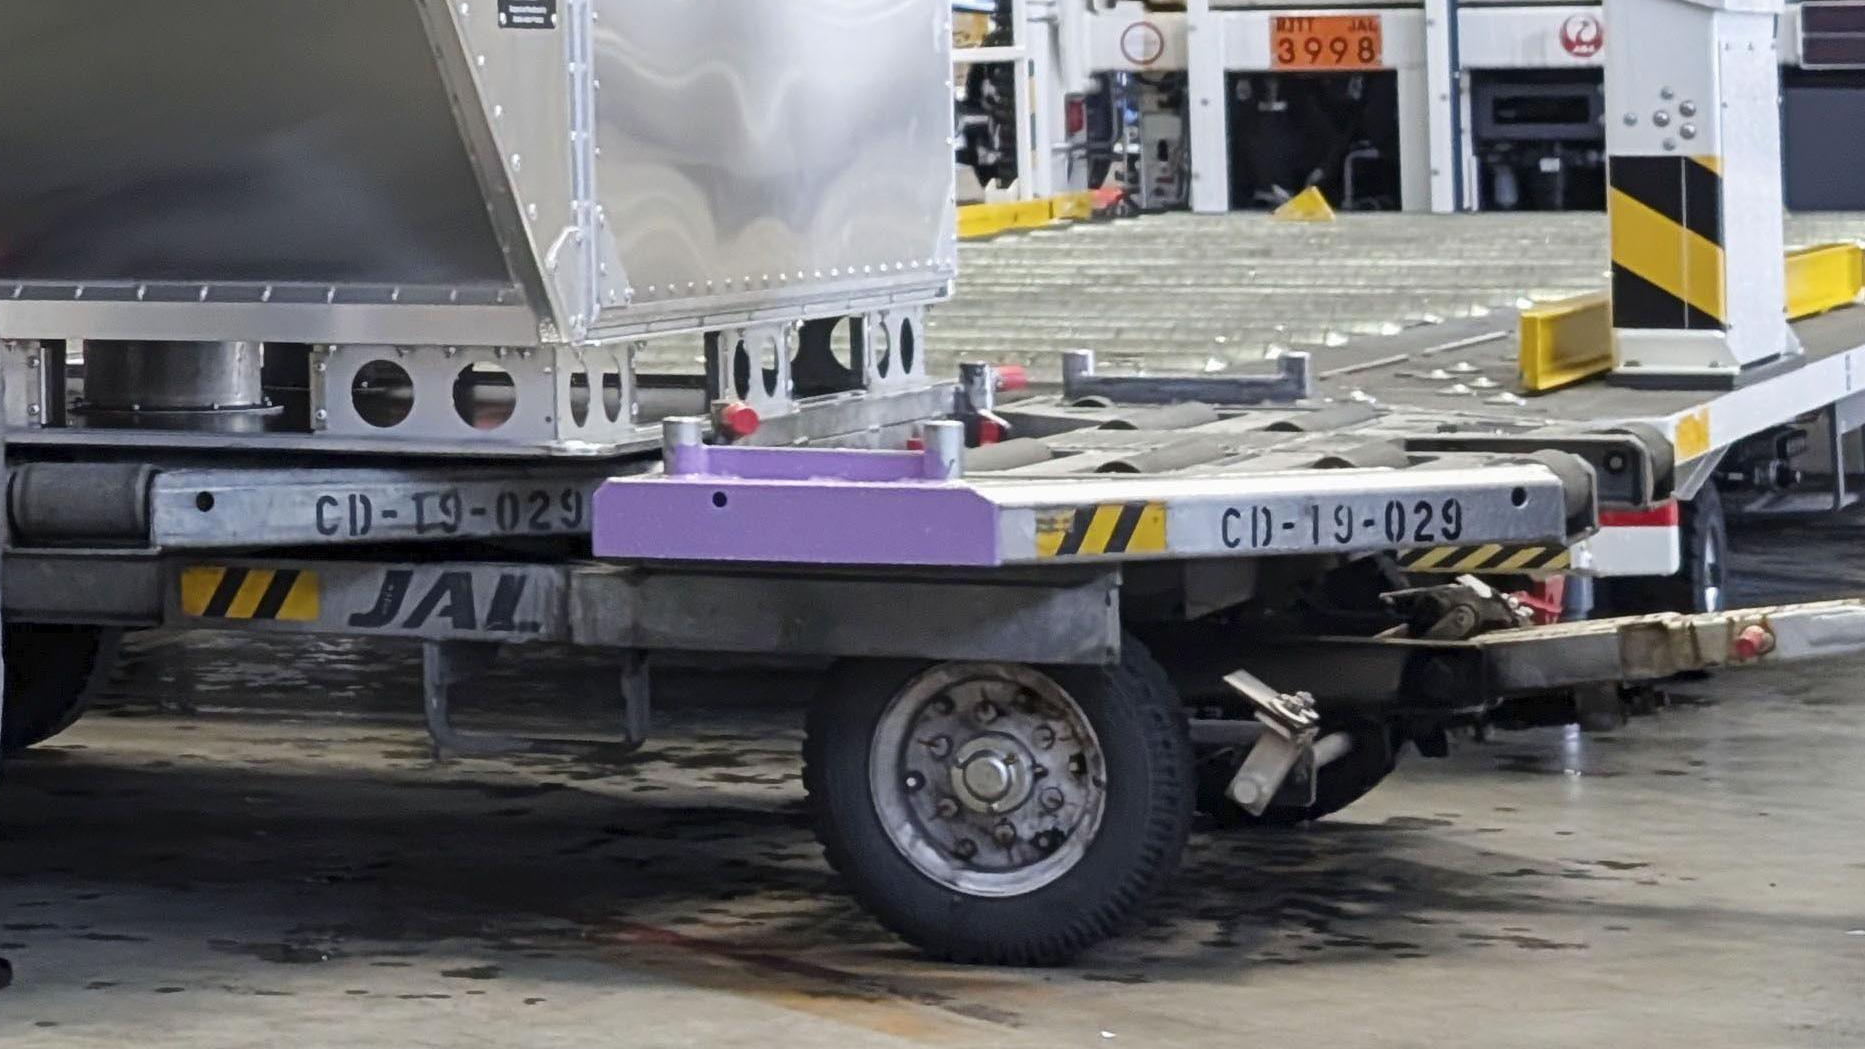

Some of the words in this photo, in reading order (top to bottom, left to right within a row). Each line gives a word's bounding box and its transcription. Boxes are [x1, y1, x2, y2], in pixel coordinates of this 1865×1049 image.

[1348, 18, 1378, 32] JAL
[1278, 36, 1376, 64] 3998
[1222, 497, 1462, 549] CD-19-029
[348, 569, 542, 632] JAL
